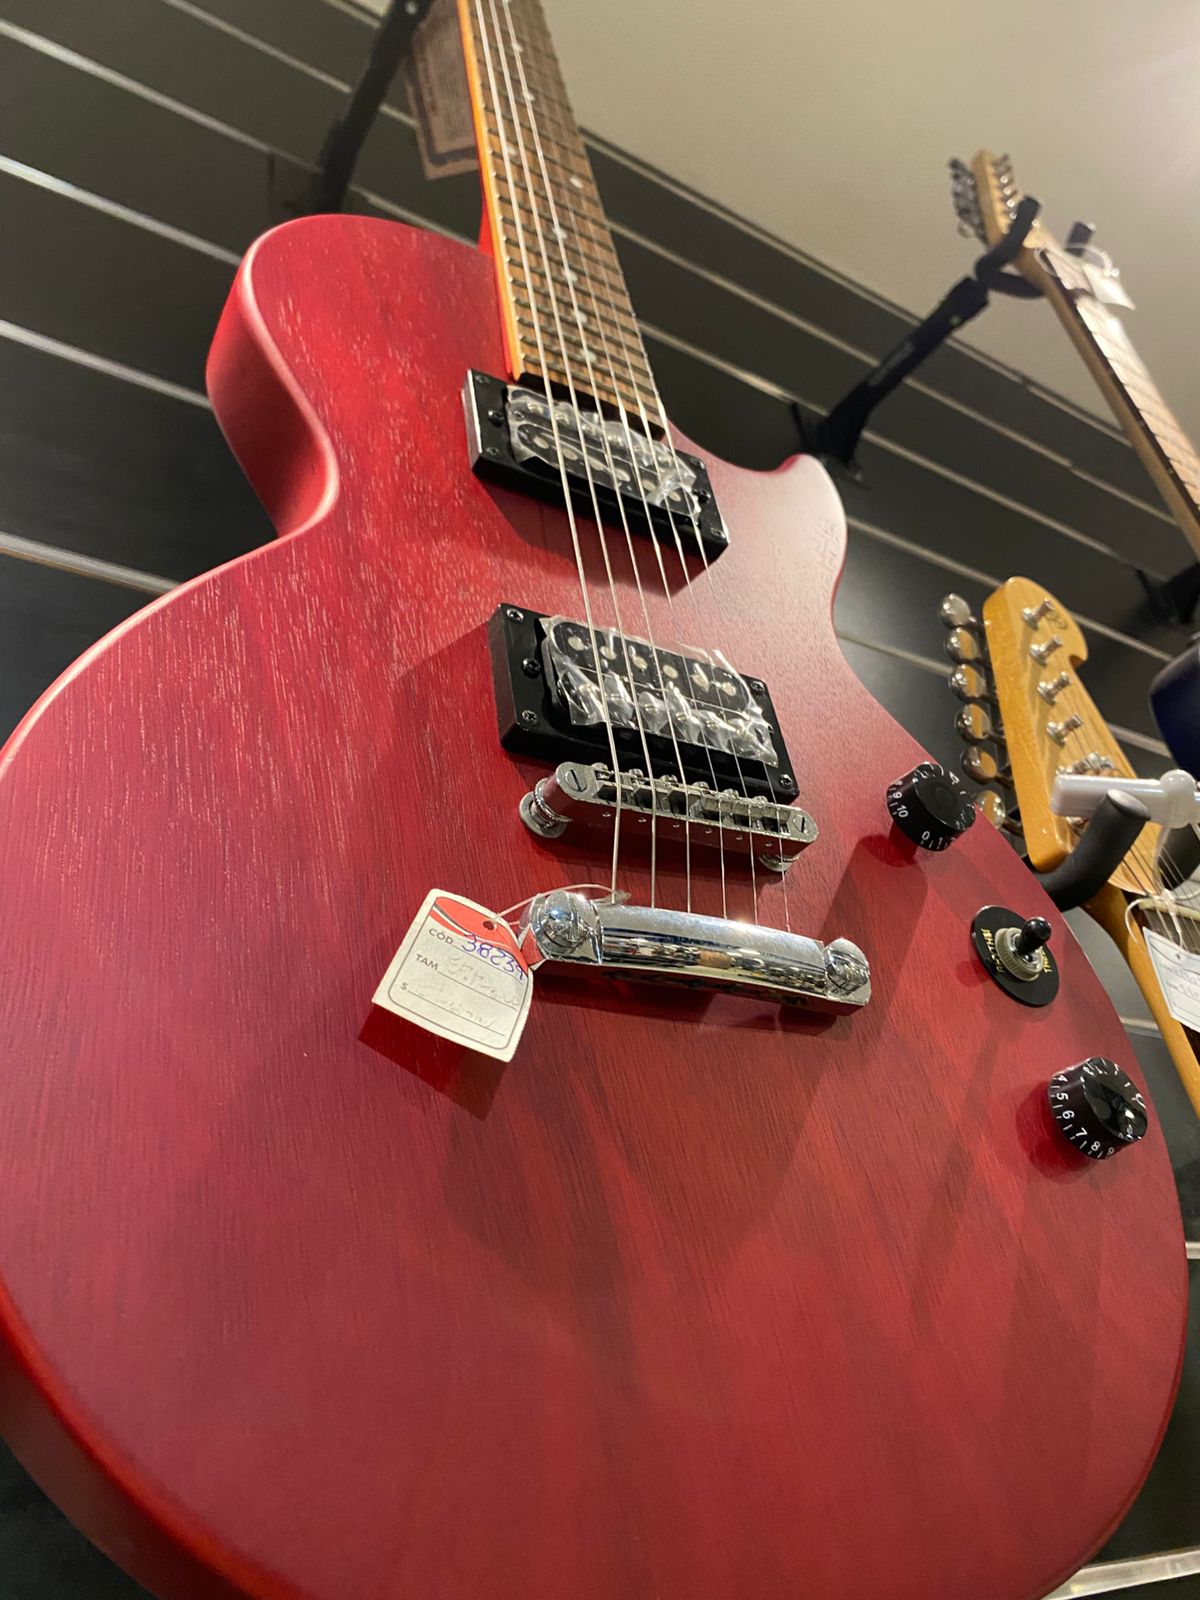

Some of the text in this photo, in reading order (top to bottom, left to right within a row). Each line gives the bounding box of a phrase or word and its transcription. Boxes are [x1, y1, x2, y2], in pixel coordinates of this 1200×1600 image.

[892, 791, 903, 799] 9
[896, 804, 909, 818] 10
[921, 830, 931, 841] 0
[428, 927, 454, 945] CÓD
[415, 953, 439, 971] TAM
[1056, 1092, 1069, 1102] 5
[1062, 1110, 1075, 1120] 6
[1075, 1127, 1088, 1138] 7
[1090, 1140, 1101, 1152] 8
